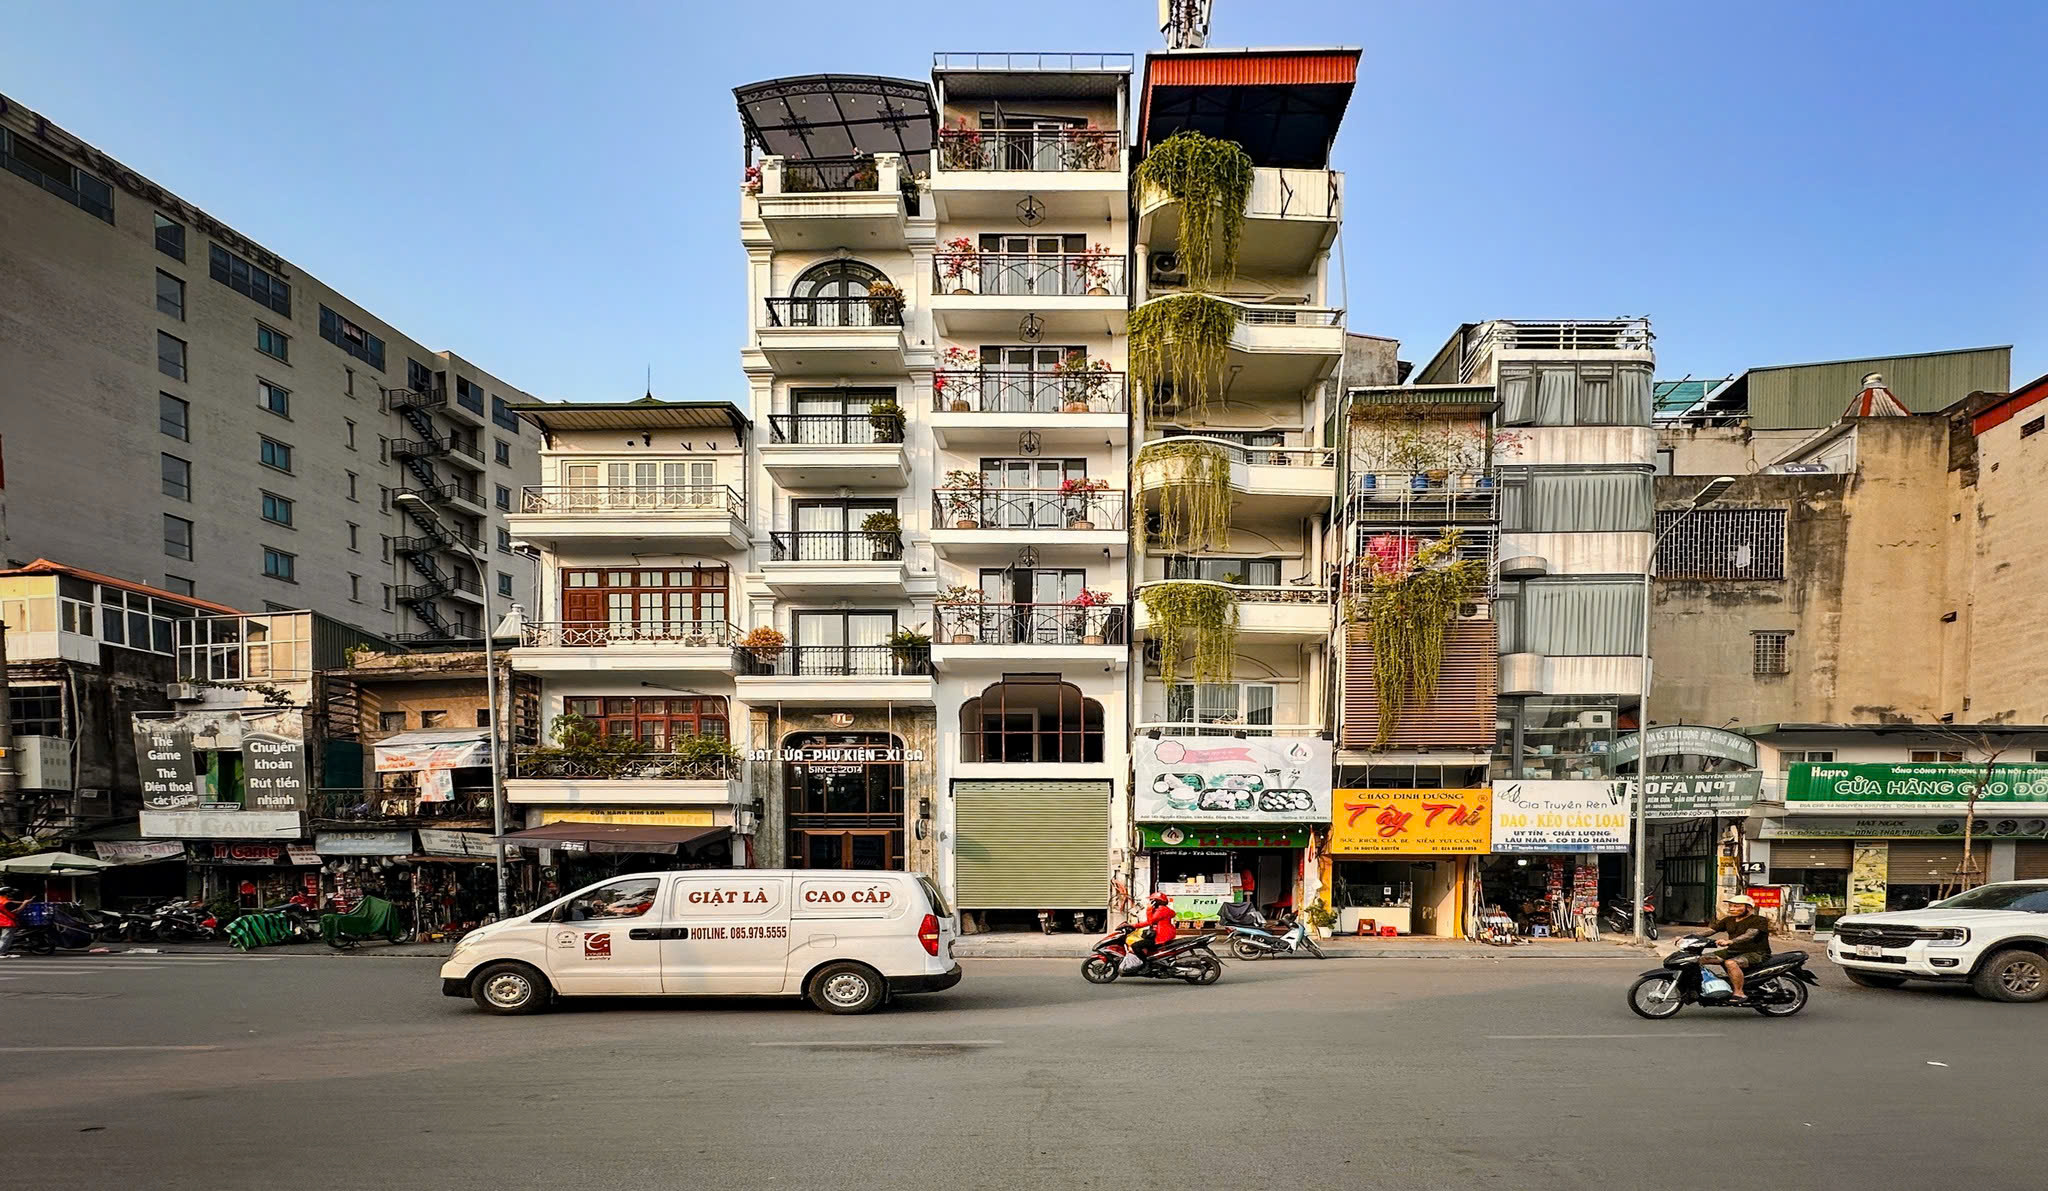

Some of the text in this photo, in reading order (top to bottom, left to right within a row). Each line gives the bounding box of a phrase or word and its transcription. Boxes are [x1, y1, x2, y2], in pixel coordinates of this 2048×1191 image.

[250, 740, 296, 755] Chuyển
[148, 750, 181, 760] Game
[777, 745, 803, 761] LỬA
[813, 749, 840, 764] PHỤ
[886, 746, 900, 761] XÌ
[255, 759, 293, 770] khoản
[808, 766, 863, 774] SINCE 2014
[1914, 766, 1936, 774] CÔNG
[157, 768, 177, 778] Thẻ
[1811, 766, 1849, 779] Hapro
[144, 781, 193, 795] Điện thoại
[251, 777, 299, 789] Rút tiền
[1834, 775, 1881, 795] CỬA
[1887, 777, 1954, 795] HÀNG
[257, 795, 294, 805] nhanh
[1518, 801, 1539, 809] Gia
[1344, 802, 1413, 837] Tây
[1500, 811, 1625, 831] DAO KÉO CÁC LOẠI
[231, 843, 280, 859] Game
[1742, 863, 1761, 872] 14
[688, 885, 891, 907] GIẶT LÀ CAO CẤP
[691, 926, 787, 940] HOTLINE. 085.979.5555
